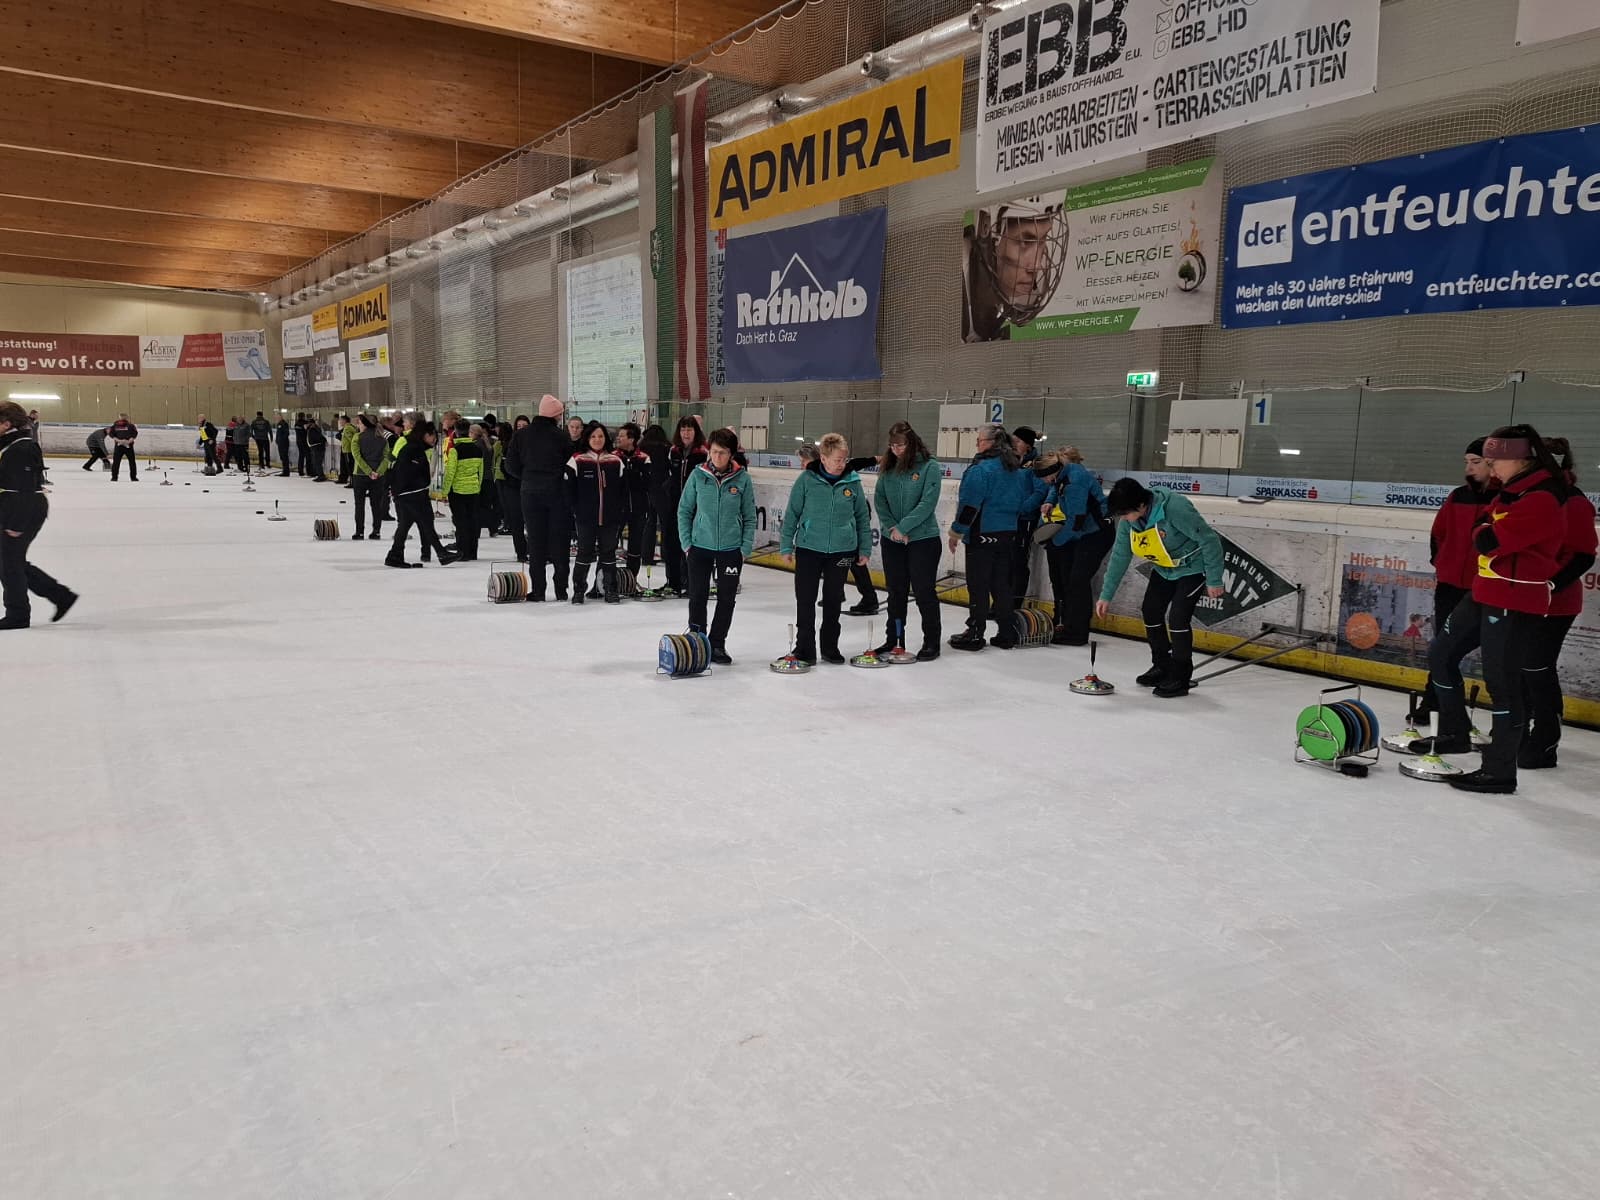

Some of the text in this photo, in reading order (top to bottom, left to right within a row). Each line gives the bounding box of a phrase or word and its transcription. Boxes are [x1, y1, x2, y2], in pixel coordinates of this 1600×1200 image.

[1171, 7, 1248, 50] EBB_HD
[986, 0, 1128, 107] EBB
[984, 95, 1038, 123] ERDBEWEGUNG
[1046, 67, 1125, 101] BAUSTOFFHANDEL
[997, 84, 1139, 150] MINIBAGGERARBEITEN
[1153, 19, 1352, 99] GARTENGESTALTUNG
[996, 139, 1045, 173] FLIESEN
[1056, 111, 1138, 157] NATURSTEIN
[1155, 51, 1347, 130] TERRASSENPLATTEN
[714, 85, 952, 218] ADMIRAL
[1244, 221, 1287, 247] der
[1236, 269, 1414, 299] Mehr als 30 Jahre Erfahrung
[343, 292, 387, 332] ADMIRAL
[736, 277, 868, 328] Rathkolb
[1235, 286, 1382, 315] machen den Unterschied
[736, 332, 753, 345] Dach
[754, 331, 769, 344] Hart
[778, 330, 798, 343] Graz
[1, 355, 135, 371] ng-wolf.com
[778, 406, 785, 423] 3
[991, 403, 1004, 423] 2
[1255, 397, 1267, 424] 1
[1255, 486, 1308, 499] SPARKASSE
[1350, 551, 1409, 570] Hier bin
